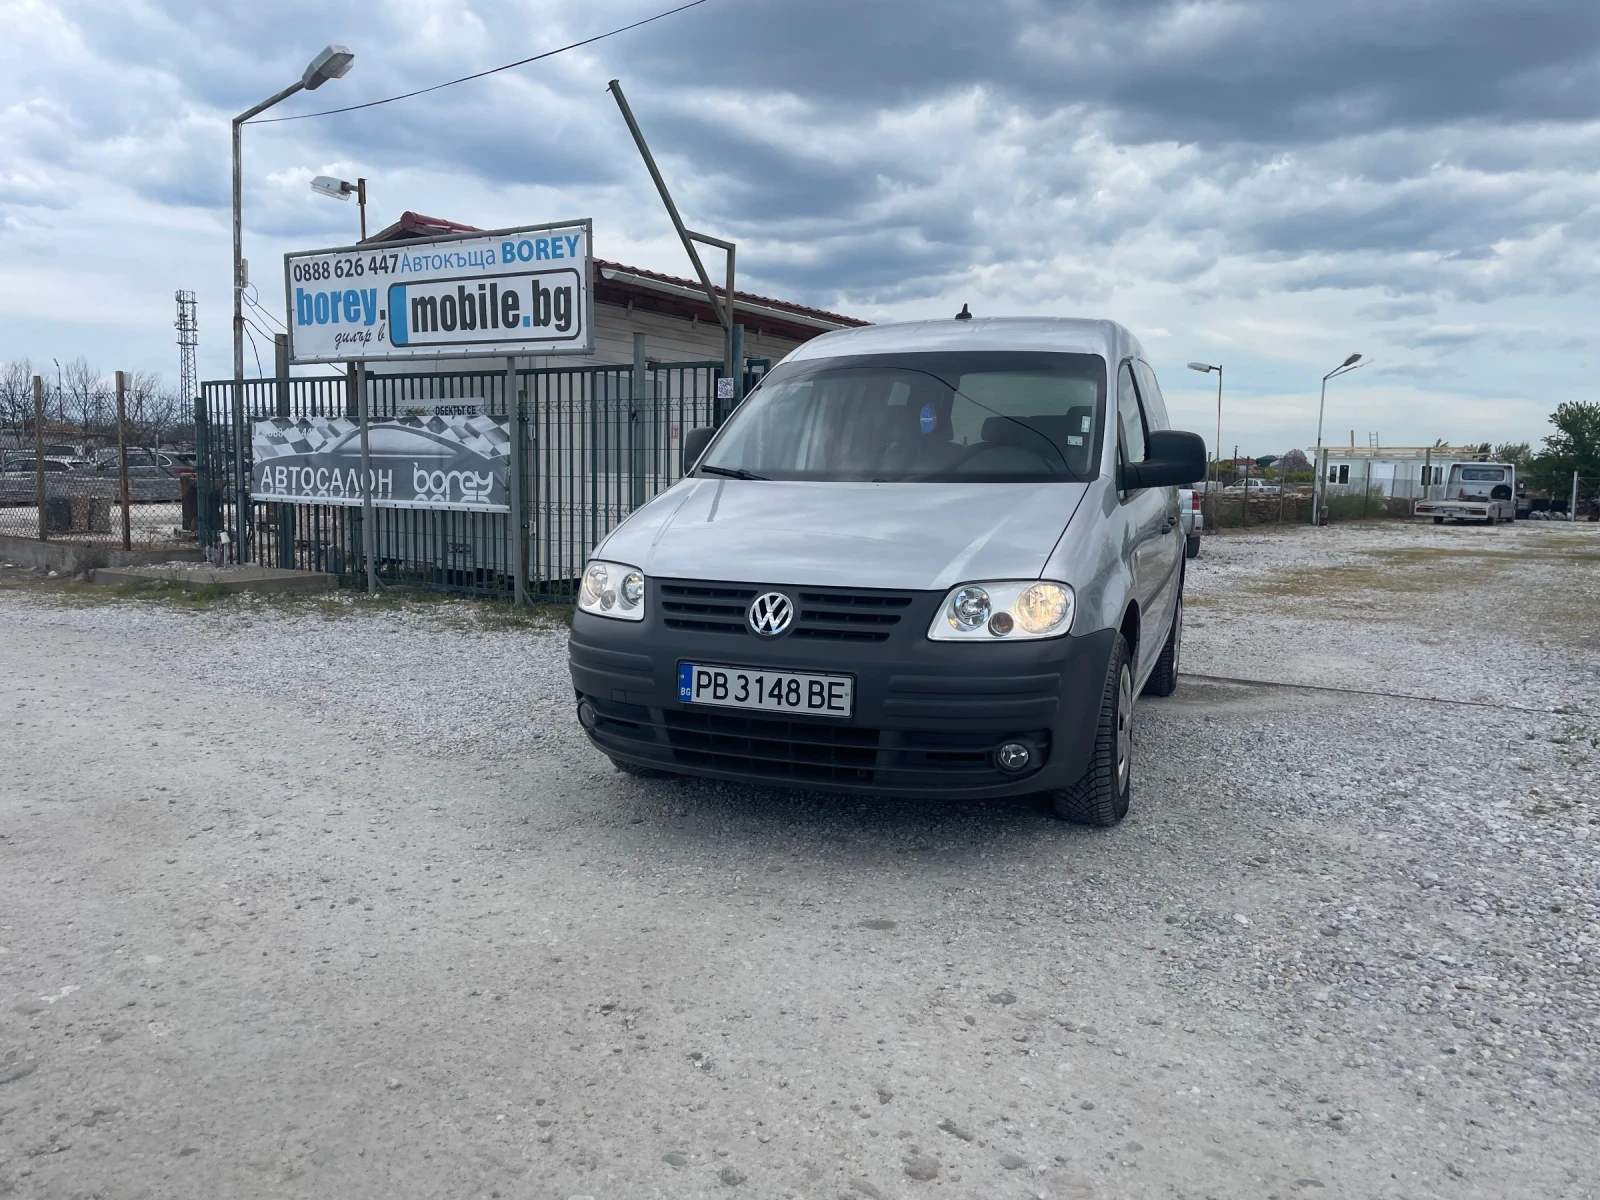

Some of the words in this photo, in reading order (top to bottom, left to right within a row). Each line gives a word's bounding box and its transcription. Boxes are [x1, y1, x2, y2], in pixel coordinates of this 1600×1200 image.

[293, 261, 331, 283] 0888
[334, 257, 365, 278] 626
[368, 253, 399, 276] 447
[501, 234, 581, 264] BOREY
[411, 279, 573, 333] mobile.bg
[260, 465, 392, 493] АВТОСАЛОН
[413, 462, 493, 497] borey
[680, 687, 691, 696] BG
